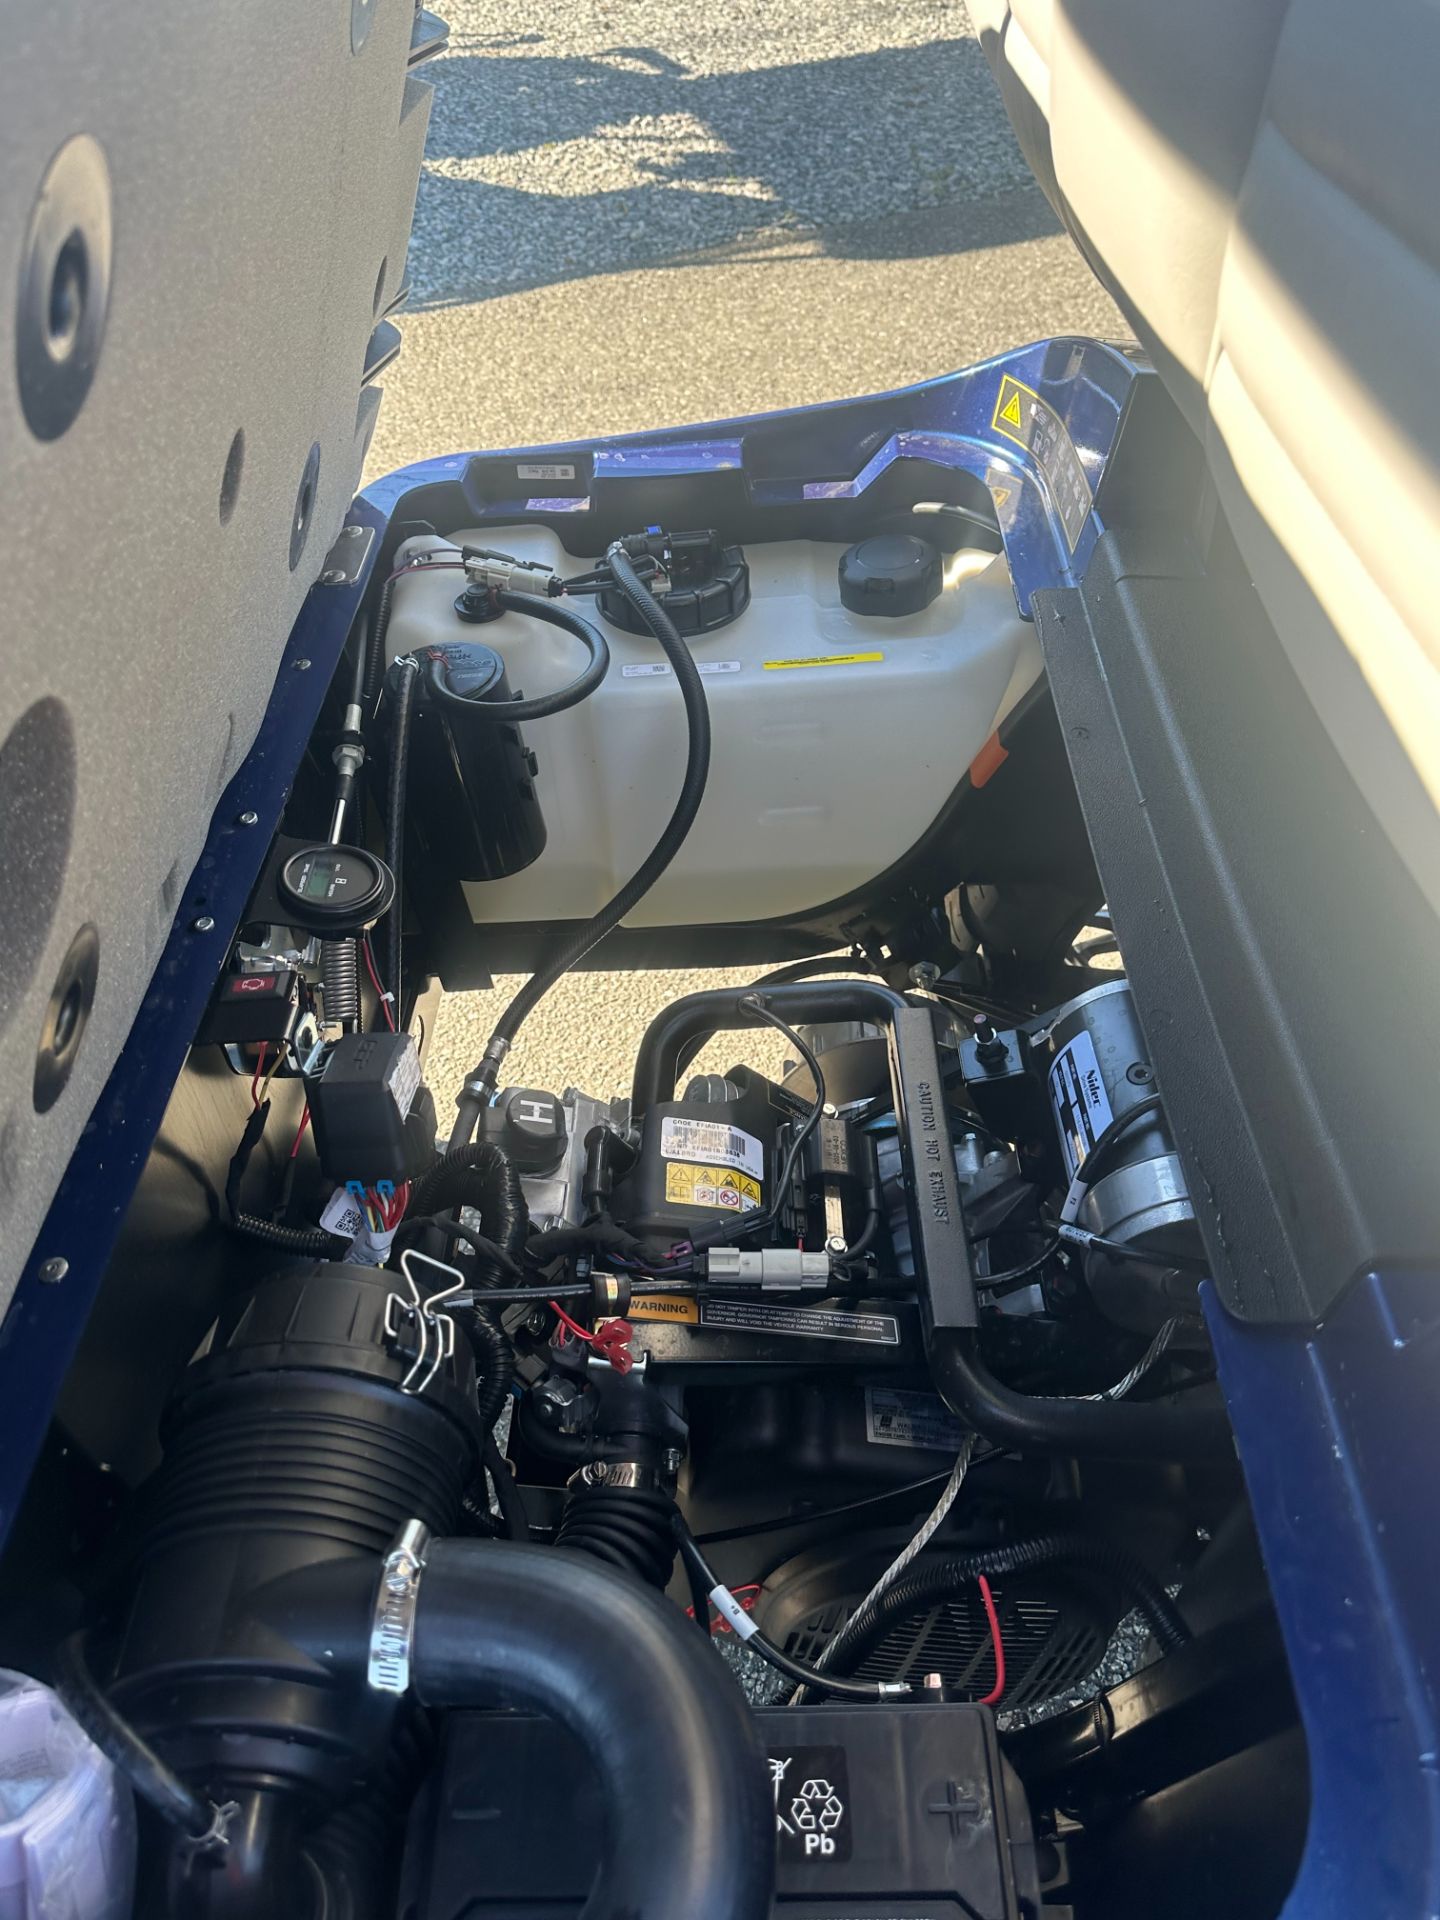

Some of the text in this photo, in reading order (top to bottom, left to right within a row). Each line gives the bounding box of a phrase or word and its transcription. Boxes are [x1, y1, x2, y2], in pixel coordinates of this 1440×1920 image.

[917, 1081, 950, 1225] CAUTION HOT EXHAUST
[629, 1300, 689, 1314] WARNING
[805, 1833, 836, 1855] Pb
